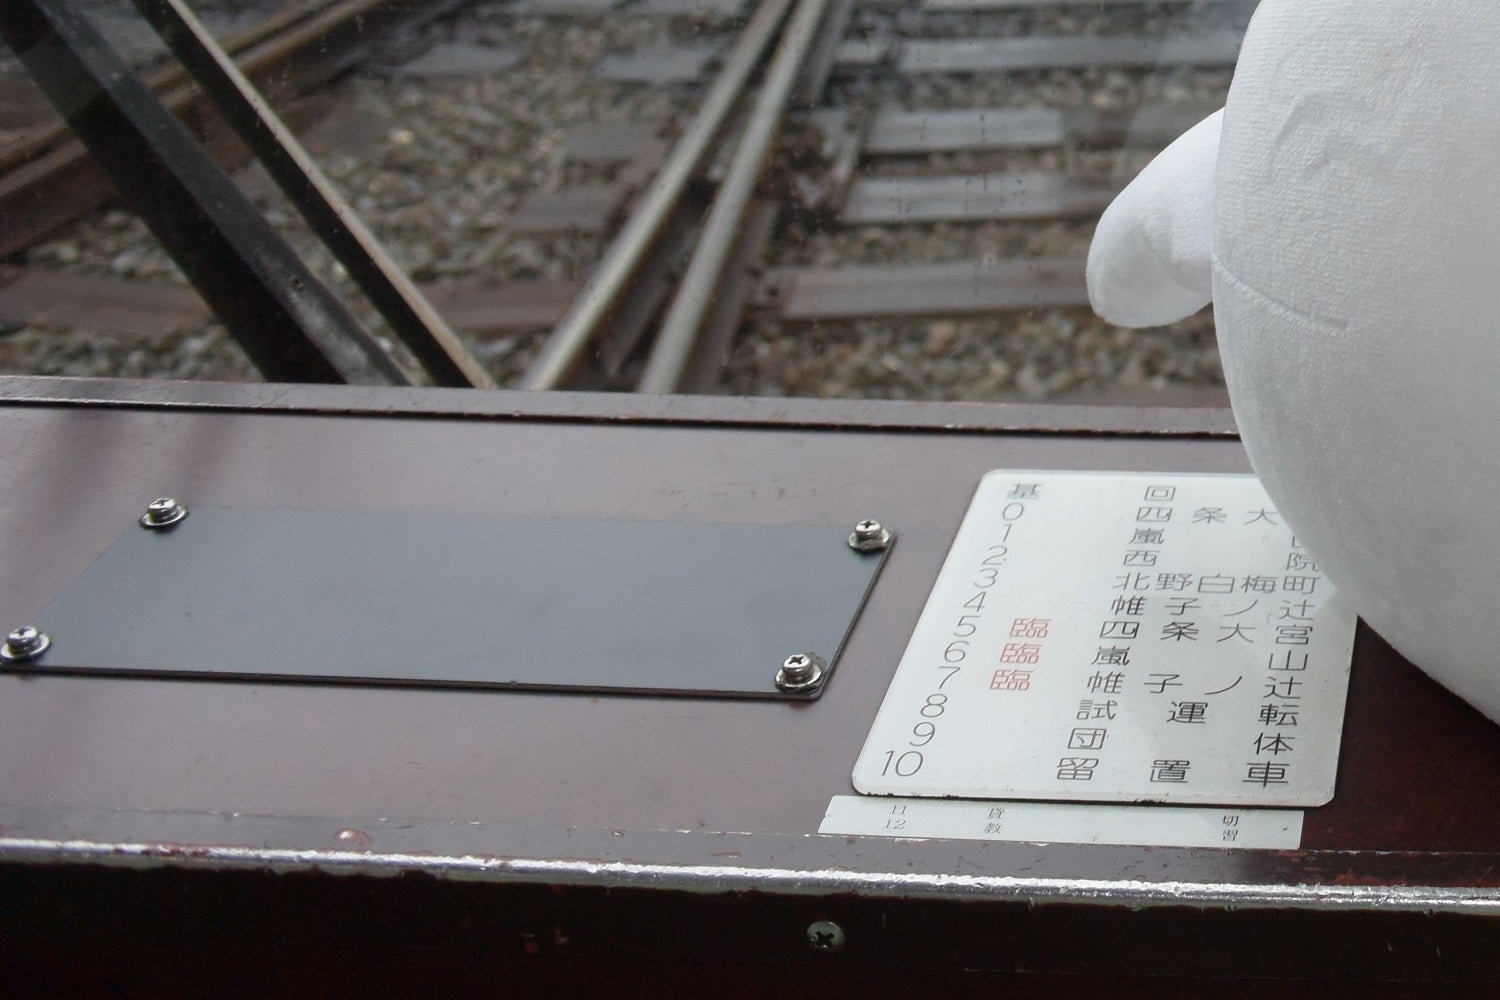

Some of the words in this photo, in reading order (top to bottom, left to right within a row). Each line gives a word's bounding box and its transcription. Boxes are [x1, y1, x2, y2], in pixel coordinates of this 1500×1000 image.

[1144, 485, 1176, 502] 回
[1001, 501, 1024, 521] 0
[1001, 523, 1013, 543] 1
[982, 545, 1008, 566] 2
[973, 568, 998, 589] 3
[1112, 572, 1323, 596] 北野白梅町
[963, 591, 986, 612] 4
[952, 615, 981, 638] 5
[1008, 617, 1053, 639] 臨
[1098, 620, 1314, 646] 四条大宮
[943, 640, 970, 663] 6
[998, 643, 1044, 665] 臨
[938, 666, 961, 690] 7
[989, 668, 1035, 691] 臨
[919, 693, 948, 718] 8
[908, 721, 936, 747] 9
[881, 750, 924, 777] 10
[891, 804, 907, 816] 11
[884, 818, 907, 830] 12
